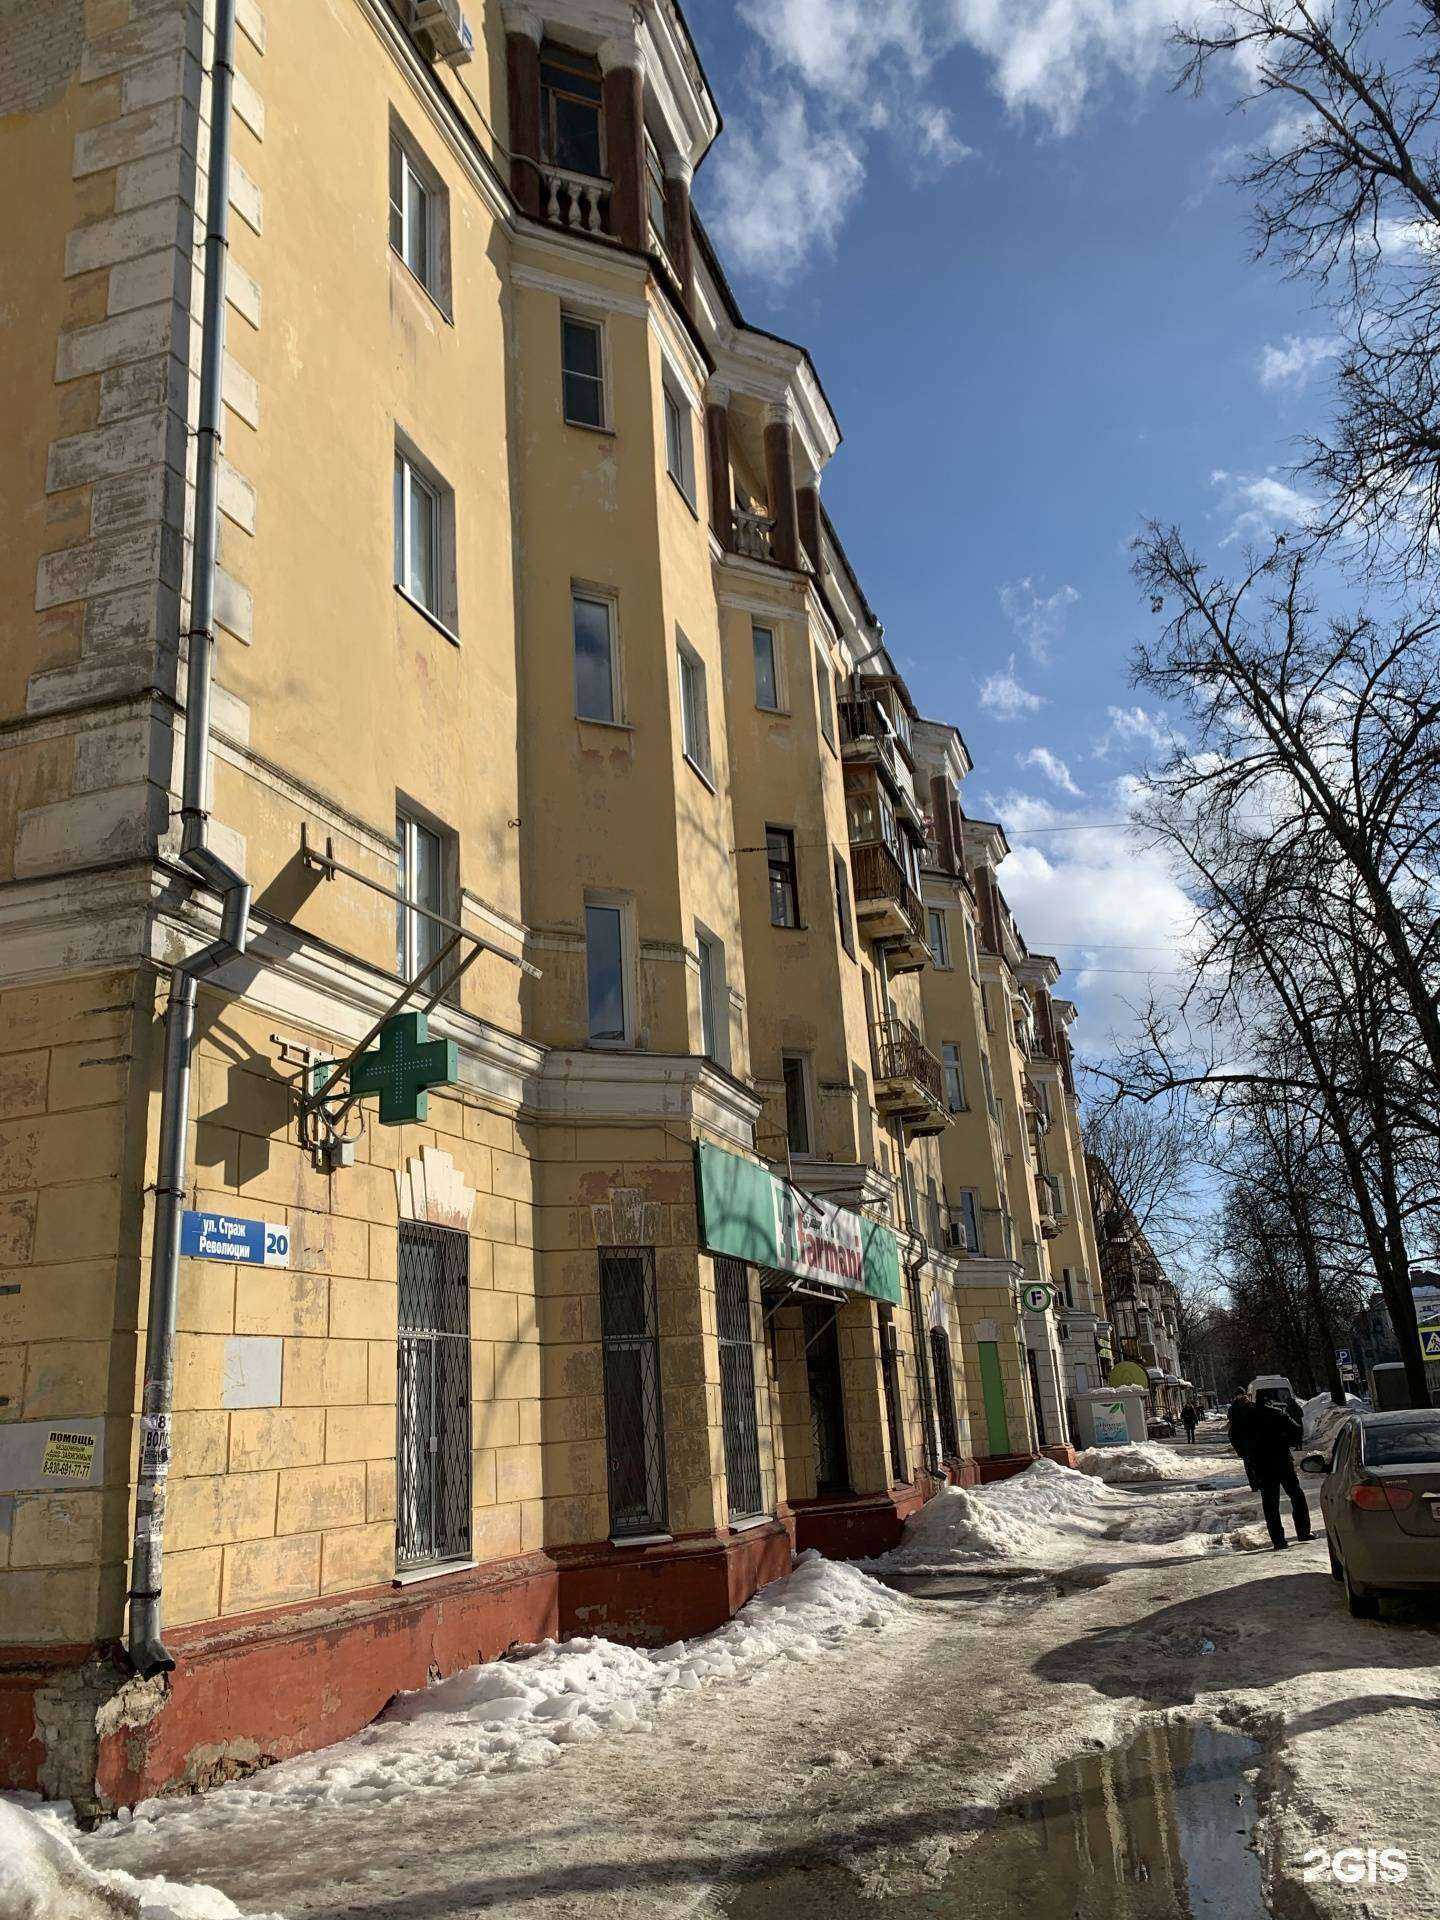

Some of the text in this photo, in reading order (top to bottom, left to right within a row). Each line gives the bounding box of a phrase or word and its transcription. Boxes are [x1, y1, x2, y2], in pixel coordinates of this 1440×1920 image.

[203, 1217, 246, 1239] ул. Страж
[199, 1235, 250, 1260] Революции
[266, 1232, 288, 1256] 20
[1030, 1290, 1042, 1306] F
